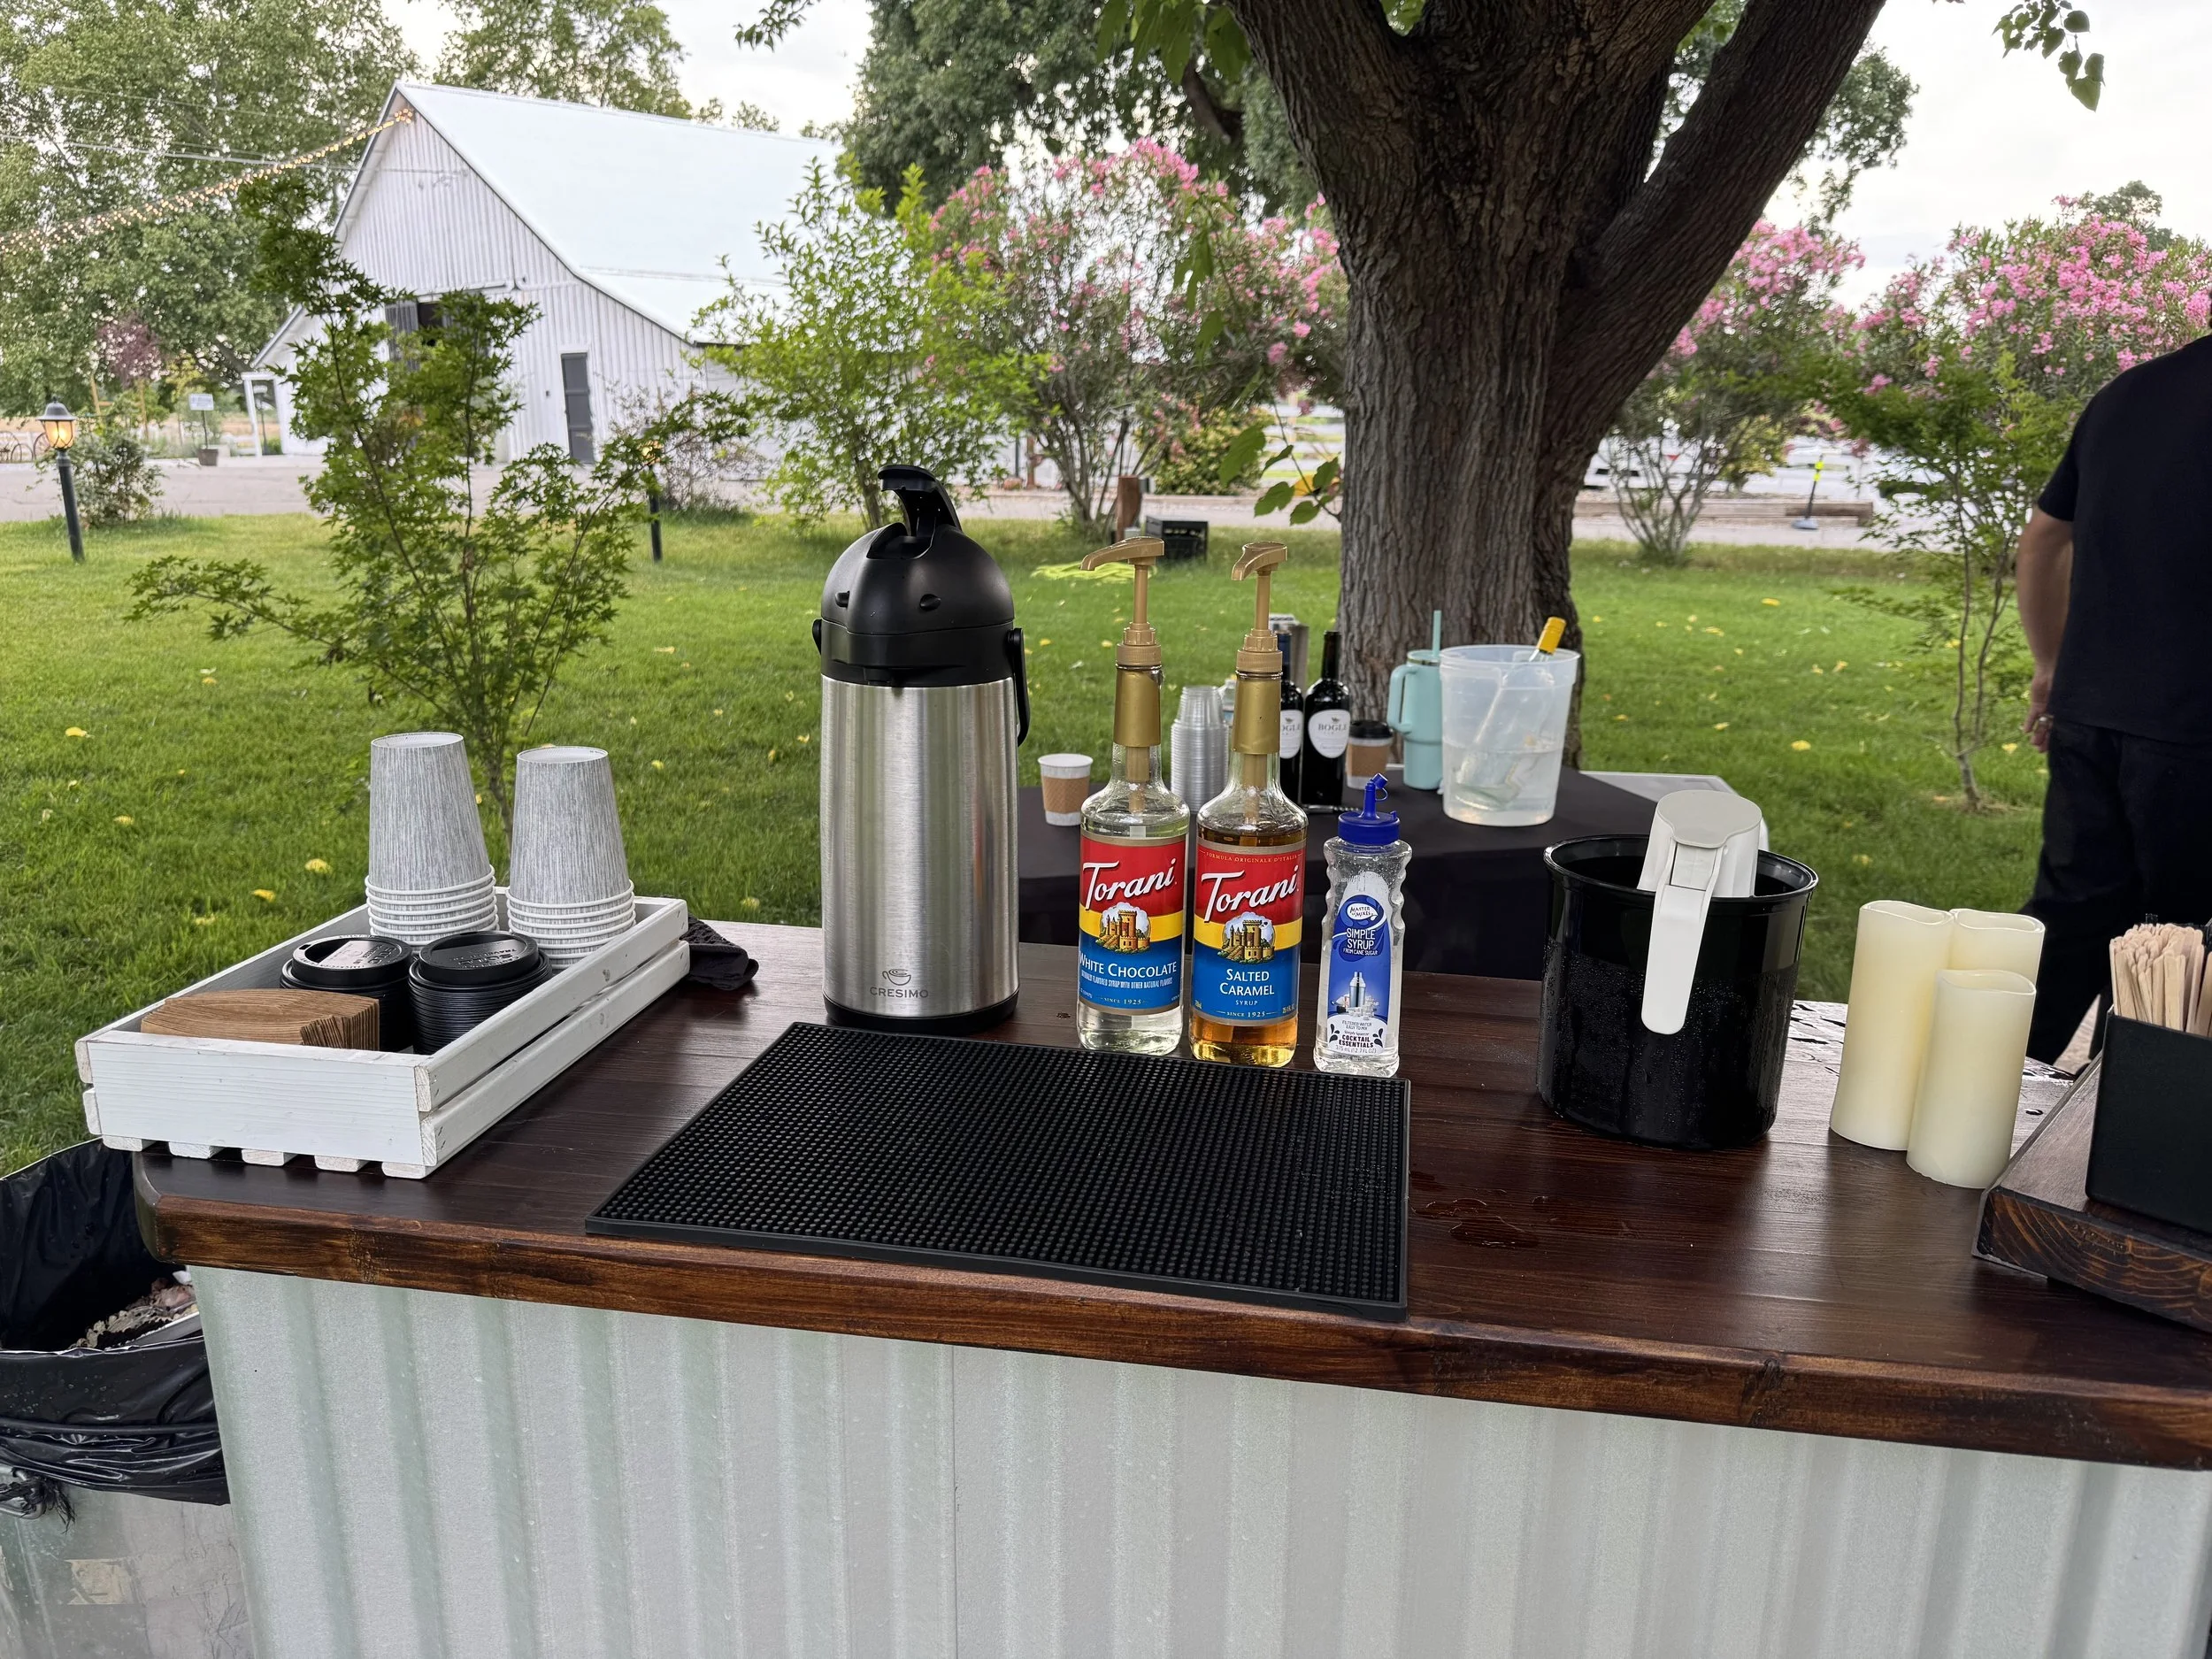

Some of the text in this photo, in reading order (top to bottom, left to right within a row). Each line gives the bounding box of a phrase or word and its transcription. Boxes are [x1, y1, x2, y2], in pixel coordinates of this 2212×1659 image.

[1206, 851, 1233, 862] FORMULA
[1083, 857, 1176, 910] Torani
[1202, 864, 1298, 922] Torani
[1347, 927, 1376, 940] SIMPLE
[1348, 939, 1374, 949] SYRUP
[1079, 953, 1177, 978] WHITE CHOCOLATE
[1226, 969, 1270, 982] SALTED
[870, 987, 928, 998] CRESIMO
[1219, 982, 1274, 996] CARAMEL
